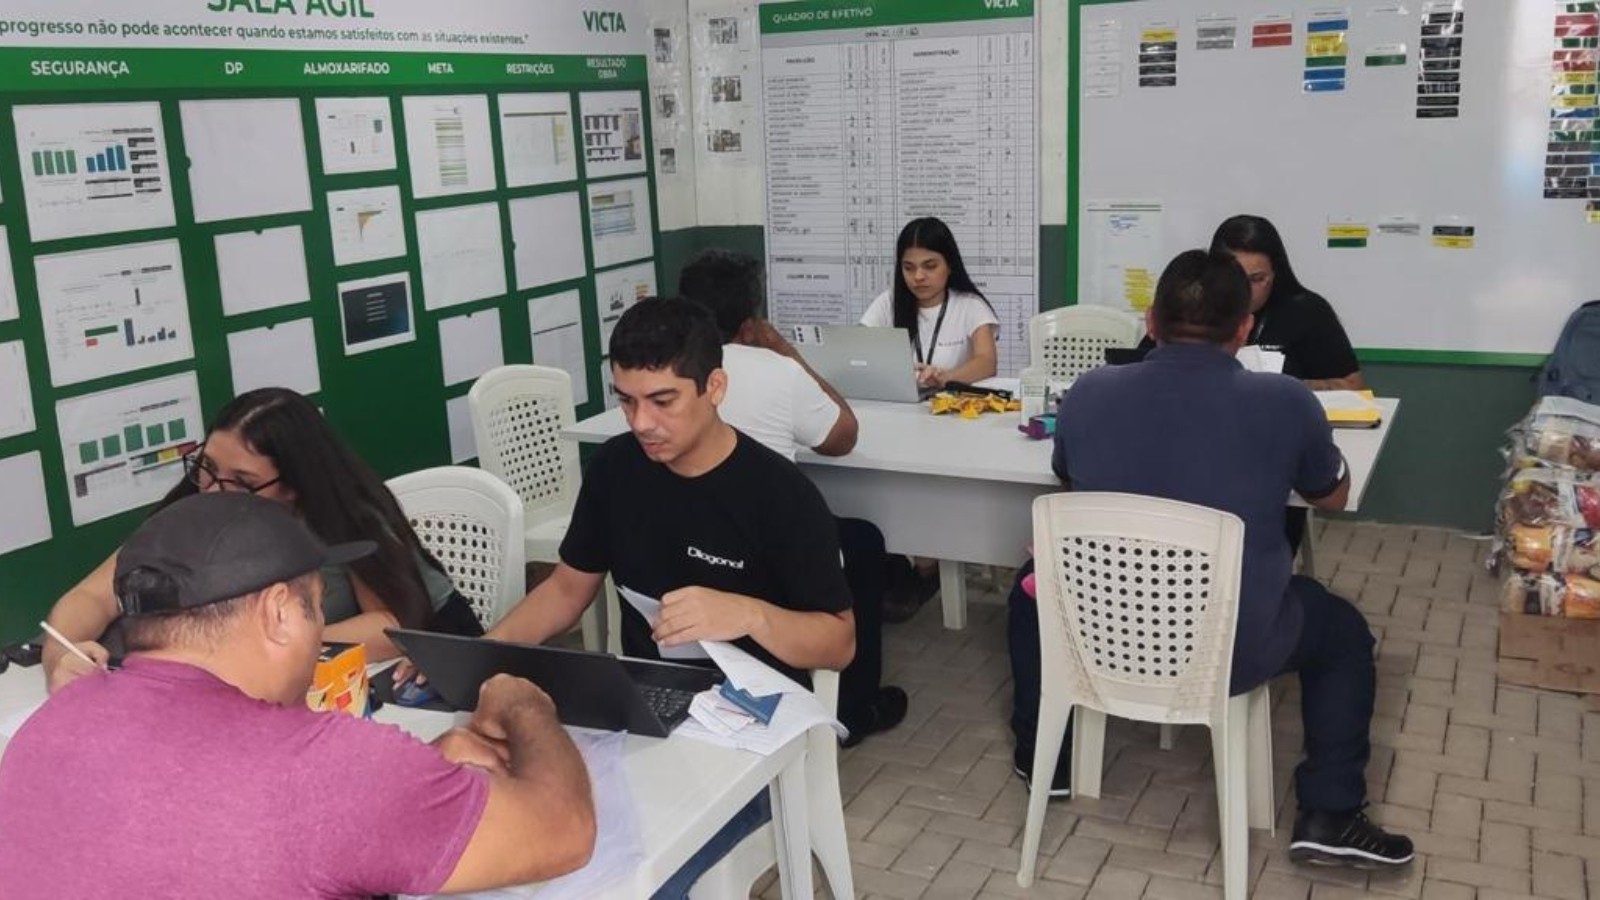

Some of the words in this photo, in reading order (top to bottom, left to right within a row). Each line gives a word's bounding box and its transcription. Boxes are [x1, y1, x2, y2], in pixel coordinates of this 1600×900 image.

[583, 10, 627, 33] VICTA
[773, 12, 814, 24] QUADRO
[816, 10, 830, 20] DE
[831, 7, 873, 19] EFETIVO
[0, 20, 83, 37] progresso
[88, 19, 117, 35] não
[122, 21, 159, 38] pode
[163, 24, 232, 37] acontecer
[237, 25, 286, 40] quando
[288, 28, 338, 40] estamos
[341, 28, 394, 42] satisfeitos
[397, 31, 419, 41] com
[422, 32, 432, 41] as
[435, 29, 478, 45] situações
[31, 60, 130, 78] SEGURANÇA
[225, 62, 244, 75] DP
[303, 62, 391, 75] ALMOXARIFADO
[427, 62, 454, 74] META
[506, 62, 555, 76] RESTRIÇÕES
[687, 546, 744, 569] Diagonal
